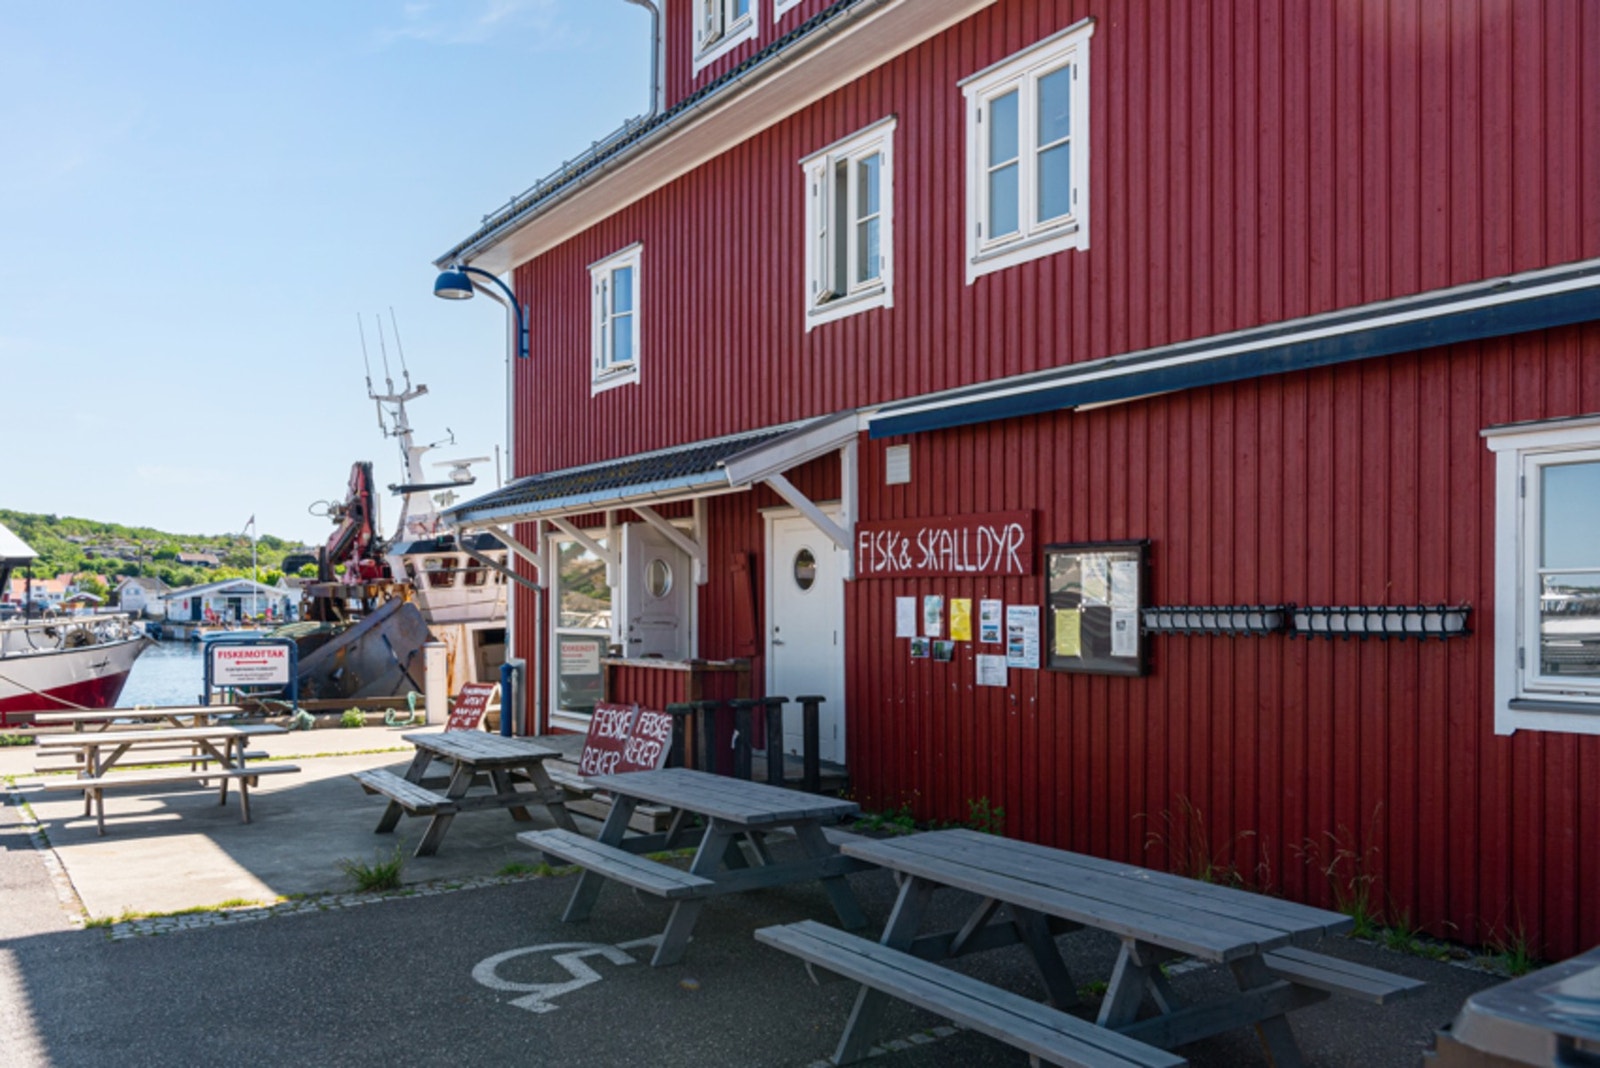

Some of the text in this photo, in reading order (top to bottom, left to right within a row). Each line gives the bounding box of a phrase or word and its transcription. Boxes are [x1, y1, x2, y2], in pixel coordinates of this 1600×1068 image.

[917, 523, 1024, 574] SKALLDYR
[218, 650, 284, 659] FISKEMOTTAK
[591, 709, 633, 740] FERSKE
[636, 711, 673, 742] FERSKE
[581, 746, 620, 775] REKER
[623, 736, 661, 768] REKER
